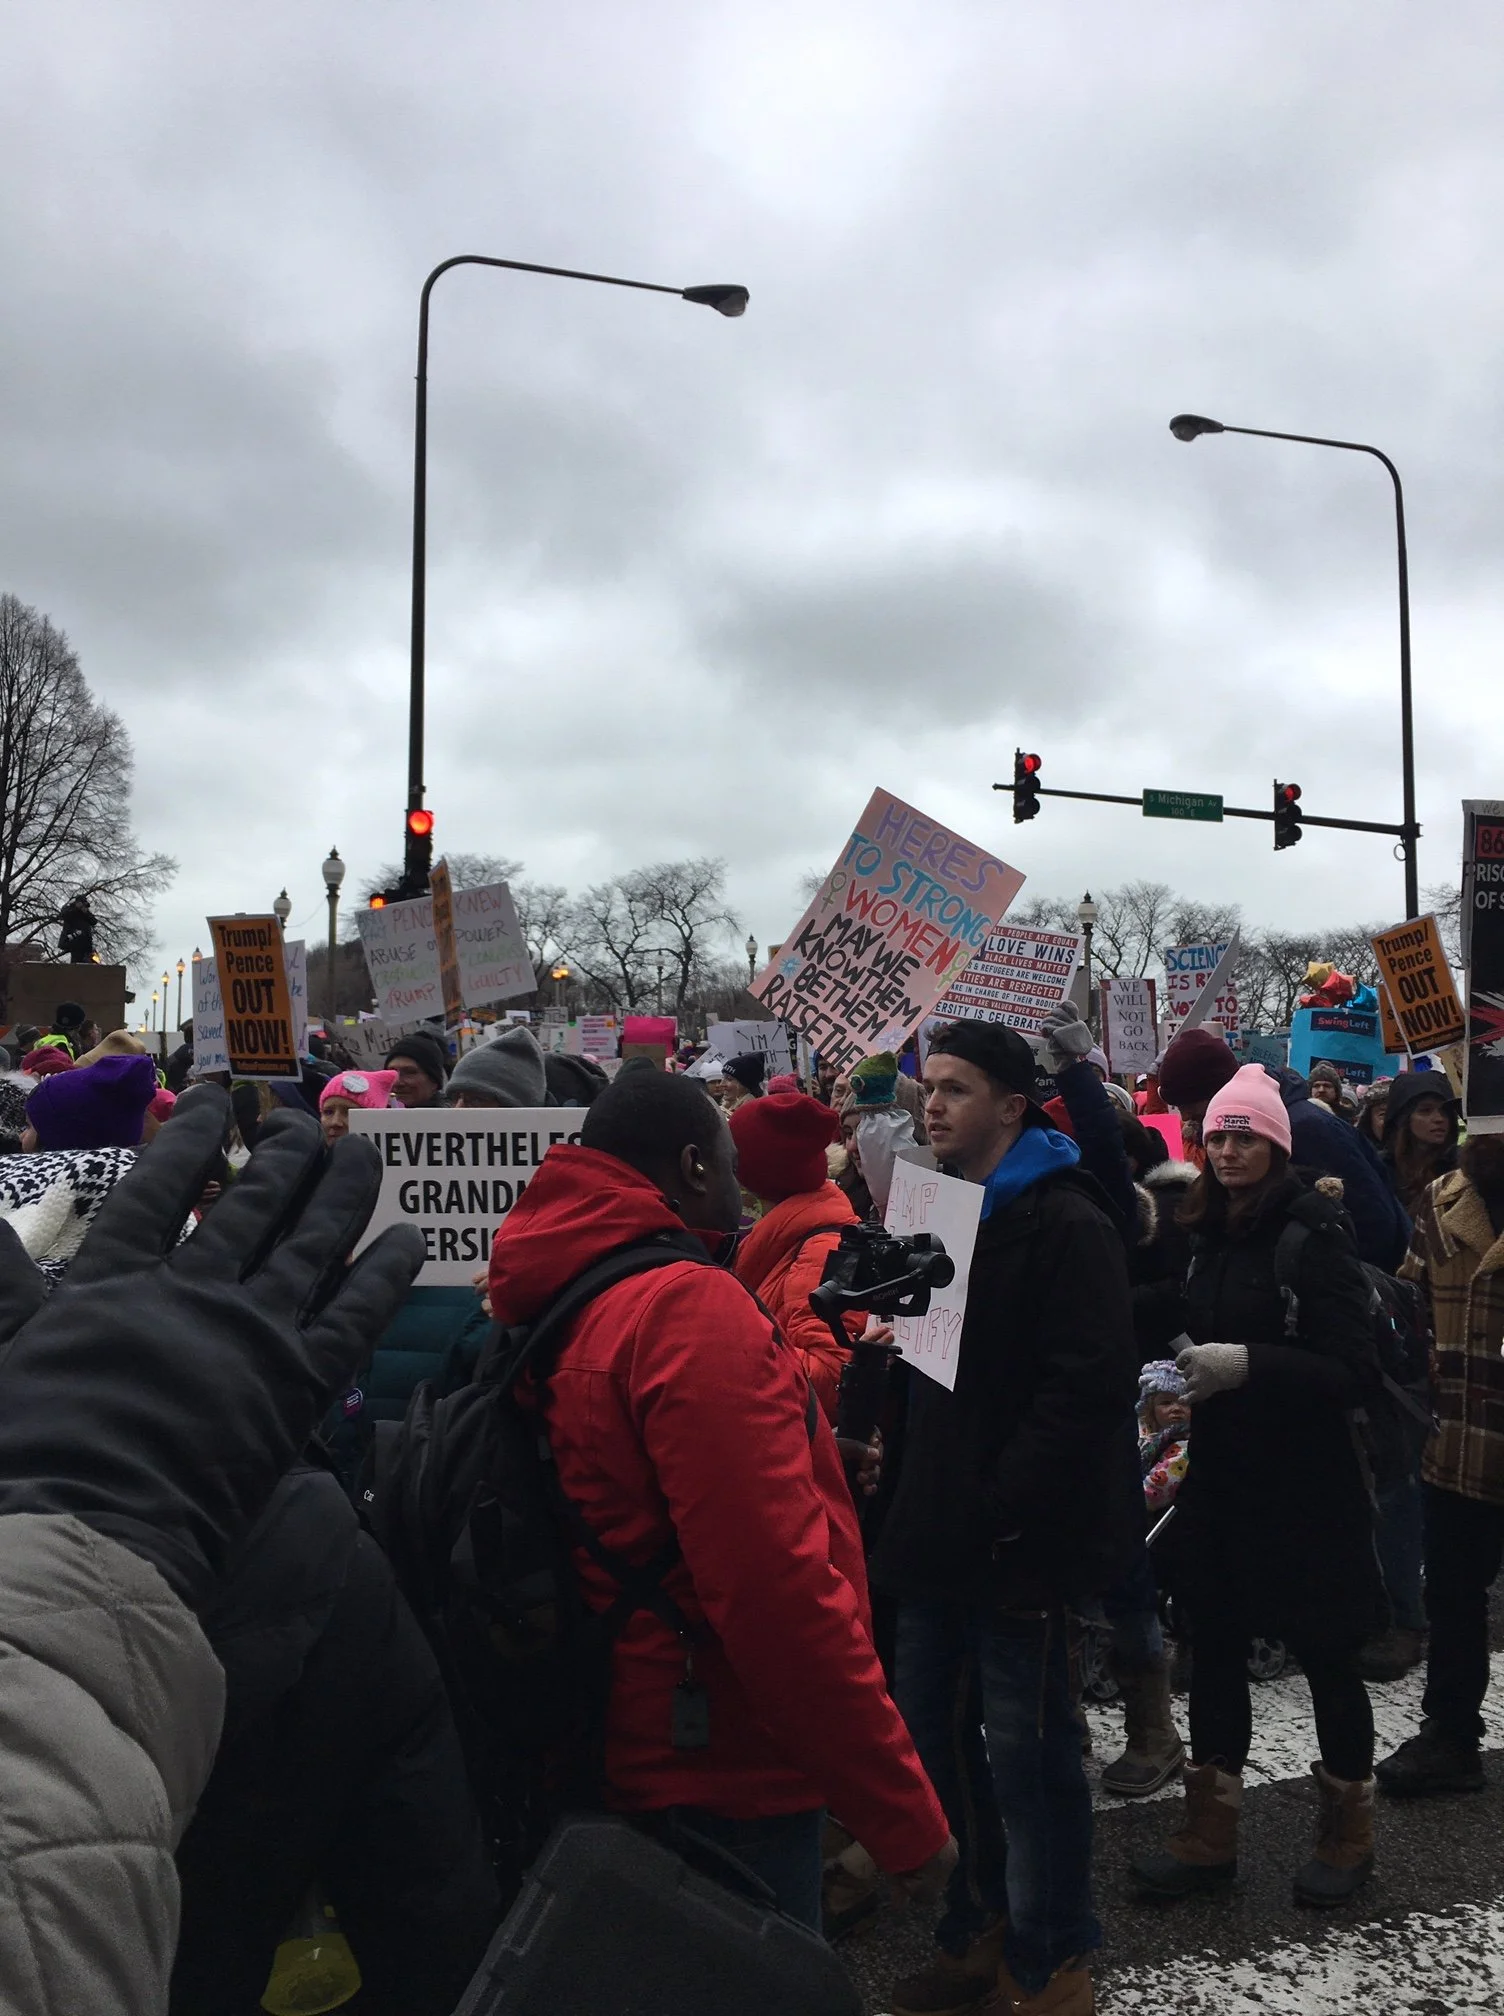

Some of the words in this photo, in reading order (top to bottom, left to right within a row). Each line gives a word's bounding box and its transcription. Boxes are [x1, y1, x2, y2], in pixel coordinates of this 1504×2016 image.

[1158, 794, 1204, 808] Michigan
[1171, 808, 1184, 816] 100
[875, 803, 1004, 893] HERES
[843, 832, 882, 877] TO
[877, 861, 992, 947] STRONG
[1475, 891, 1497, 909] OF
[392, 902, 433, 933] PENC
[455, 890, 502, 917] KNEW
[845, 879, 961, 976] WOMEN
[992, 927, 1006, 937] ALL
[1007, 929, 1032, 940] PEOPLE
[1036, 933, 1050, 943] ARE
[1052, 936, 1075, 947] EQUAL
[369, 942, 416, 967] ABUSE
[455, 920, 510, 943] POWER
[823, 912, 884, 960] MAY
[872, 941, 920, 987] WE
[988, 936, 1026, 956] LOVE
[1034, 943, 1076, 964] WINS
[225, 951, 274, 973] Pence
[984, 953, 1008, 964] BLACK
[1010, 957, 1033, 968] LIVES
[1036, 961, 1068, 974] MATTER
[1167, 943, 1228, 971] SCIENC
[1387, 948, 1433, 975] Pence
[385, 982, 436, 1009] TRUMP
[468, 963, 523, 991] GUILTY
[980, 964, 1015, 977] REFUGEES
[1016, 970, 1031, 980] ARE
[1032, 973, 1068, 986] WELCOME
[1119, 981, 1140, 993] WE
[1168, 974, 1190, 990] IS
[1398, 966, 1440, 1004] OUT
[232, 978, 275, 1014] OUT
[951, 984, 963, 992] ARE
[974, 988, 999, 998] CHARGE
[1002, 992, 1010, 1000] OF
[1012, 994, 1033, 1005] THEIR
[988, 979, 1006, 990] ARE
[1008, 980, 1060, 998] RESPECTED
[1113, 995, 1147, 1006] WILL
[935, 1001, 970, 1017] ERSITY
[974, 1008, 984, 1019] IS
[988, 1011, 1043, 1030] CELEBRAT
[954, 995, 976, 1004] PLANET
[977, 998, 990, 1007] ARE
[991, 1000, 1012, 1012] VALUED
[1014, 1005, 1030, 1014] OVER
[1215, 996, 1238, 1014] TO
[1401, 995, 1461, 1038] NOW!
[1118, 1011, 1147, 1024] NOT
[228, 1019, 290, 1055] NOW!
[1122, 1025, 1143, 1037] GO
[814, 1023, 868, 1078] THE
[1119, 1040, 1149, 1052] BACK
[1224, 1118, 1250, 1126] March
[399, 1180, 528, 1214] GRAND
[424, 1227, 500, 1262] ERSI
